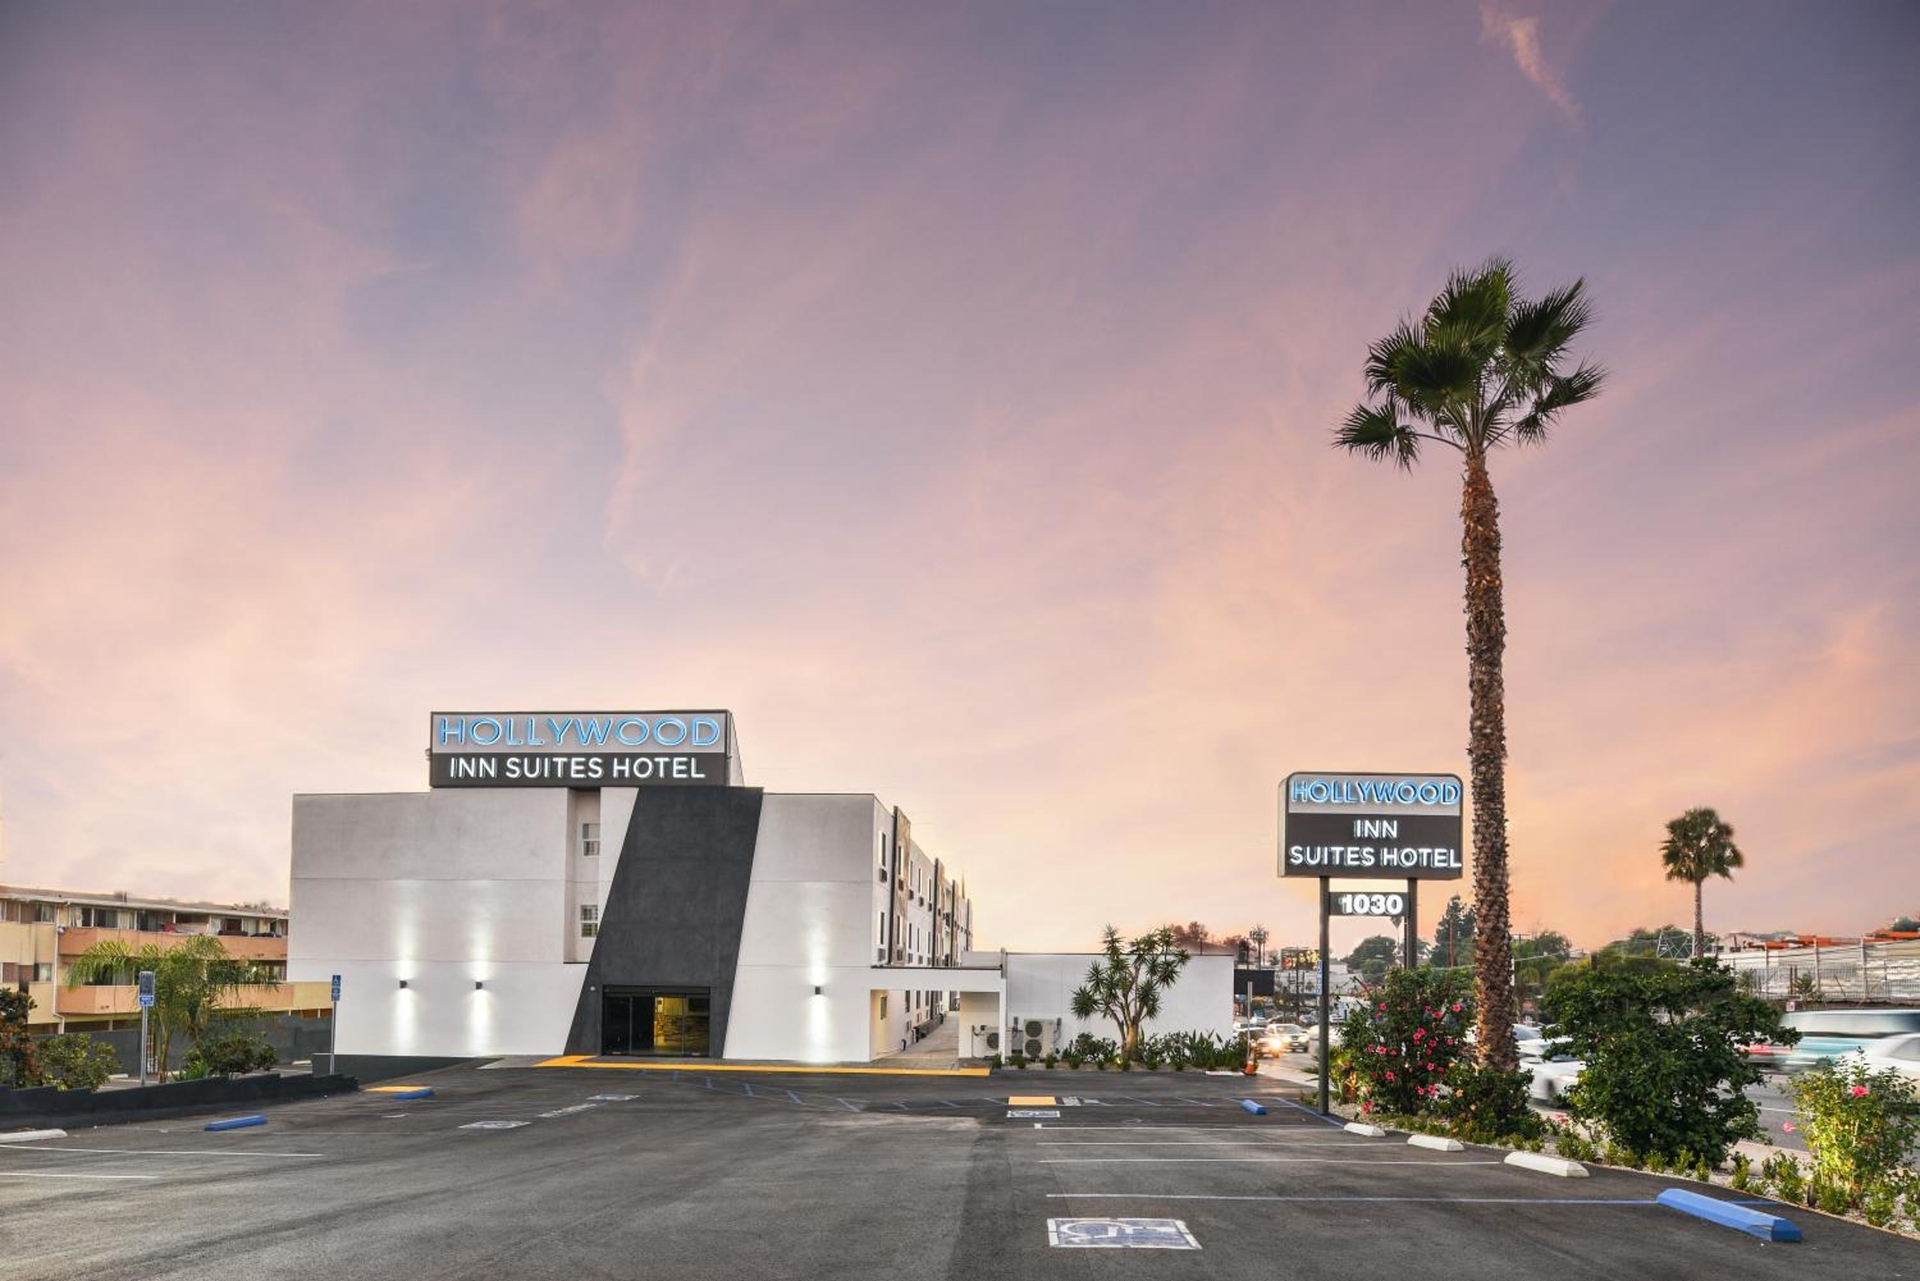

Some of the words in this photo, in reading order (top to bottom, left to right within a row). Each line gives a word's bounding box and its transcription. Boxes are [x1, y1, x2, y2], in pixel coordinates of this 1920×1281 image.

[439, 716, 721, 746] HOLLYWOOD
[450, 757, 497, 778] INN
[505, 757, 603, 779] SUITES
[613, 757, 706, 778] HOTEL
[1291, 779, 1461, 805] HOLLYWOOD
[1354, 820, 1398, 838] INN
[1290, 846, 1375, 866] SUITES
[1380, 847, 1462, 868] HOTEL
[1339, 894, 1404, 915] 1030
